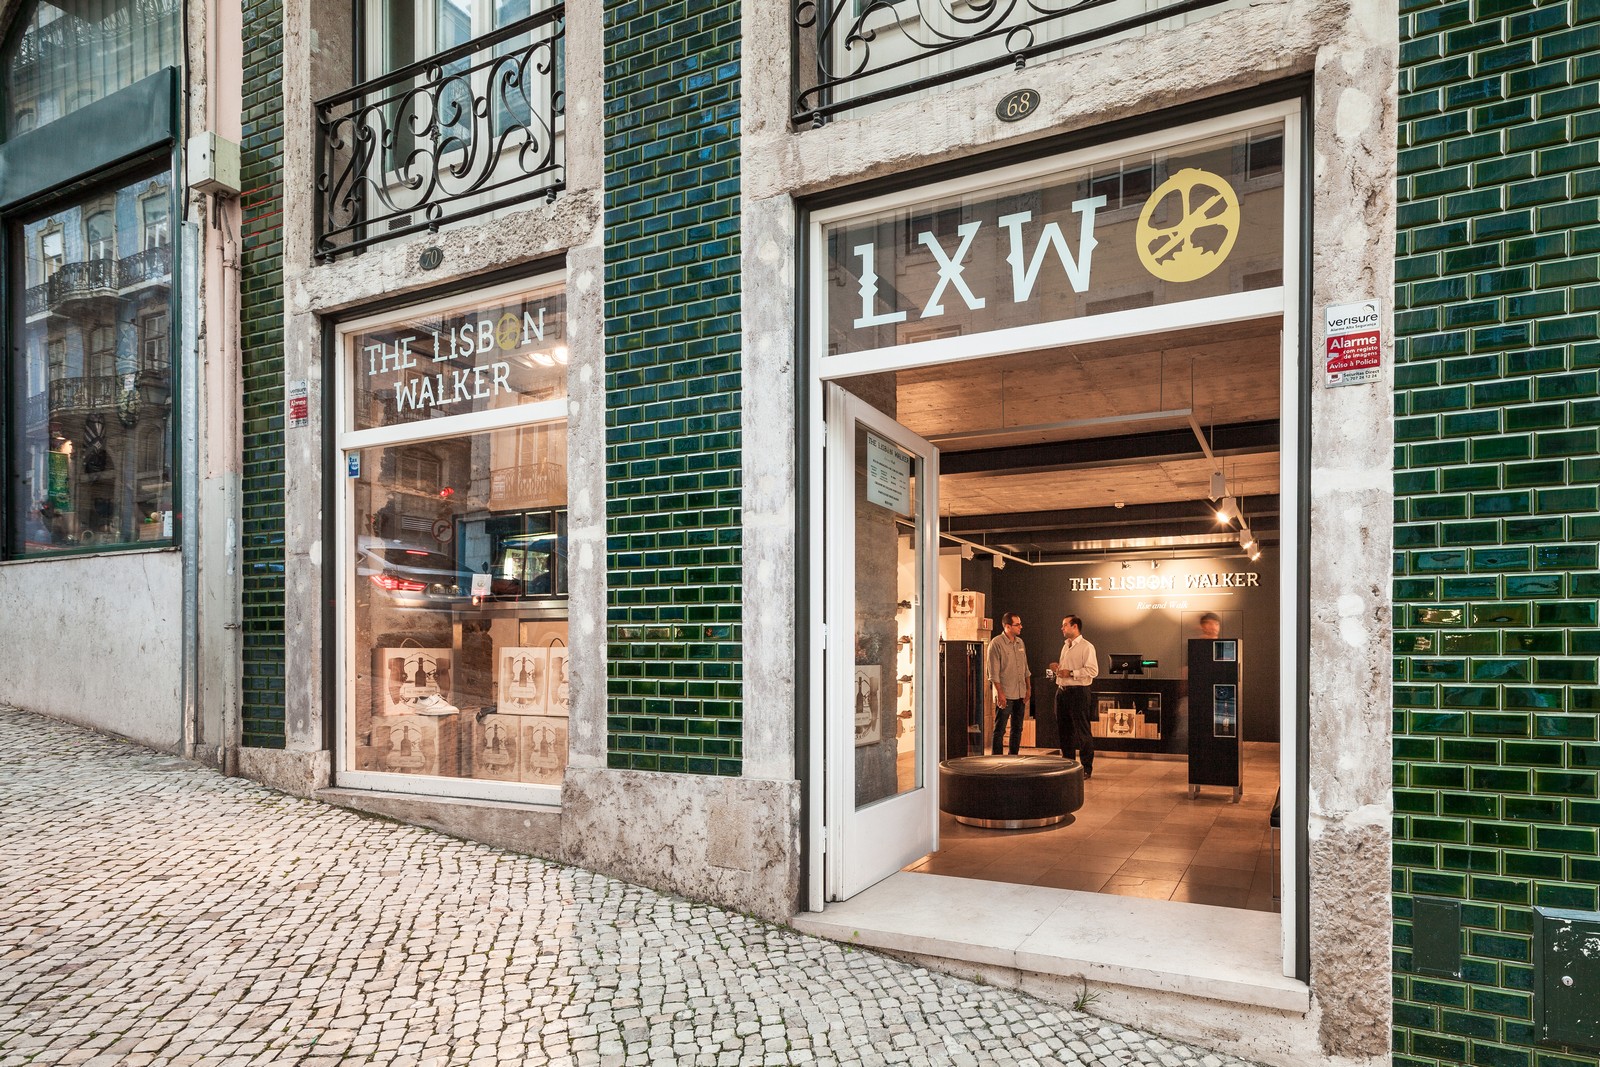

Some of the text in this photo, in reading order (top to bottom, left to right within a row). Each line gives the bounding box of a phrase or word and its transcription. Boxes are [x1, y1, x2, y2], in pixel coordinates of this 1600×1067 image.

[1006, 91, 1031, 118] 68
[425, 249, 438, 267] 70
[853, 194, 1107, 330] LXW
[1328, 313, 1379, 327] verisure
[364, 307, 546, 376] THE LISBON
[1330, 336, 1377, 350] Alarme
[1356, 345, 1379, 353] registo
[1352, 351, 1378, 359] imagens
[1329, 362, 1349, 370] Aviso
[393, 361, 512, 412] WALKER
[1069, 572, 1261, 592] THE LISBON WALKER
[1136, 600, 1188, 610] Rise and Walk
